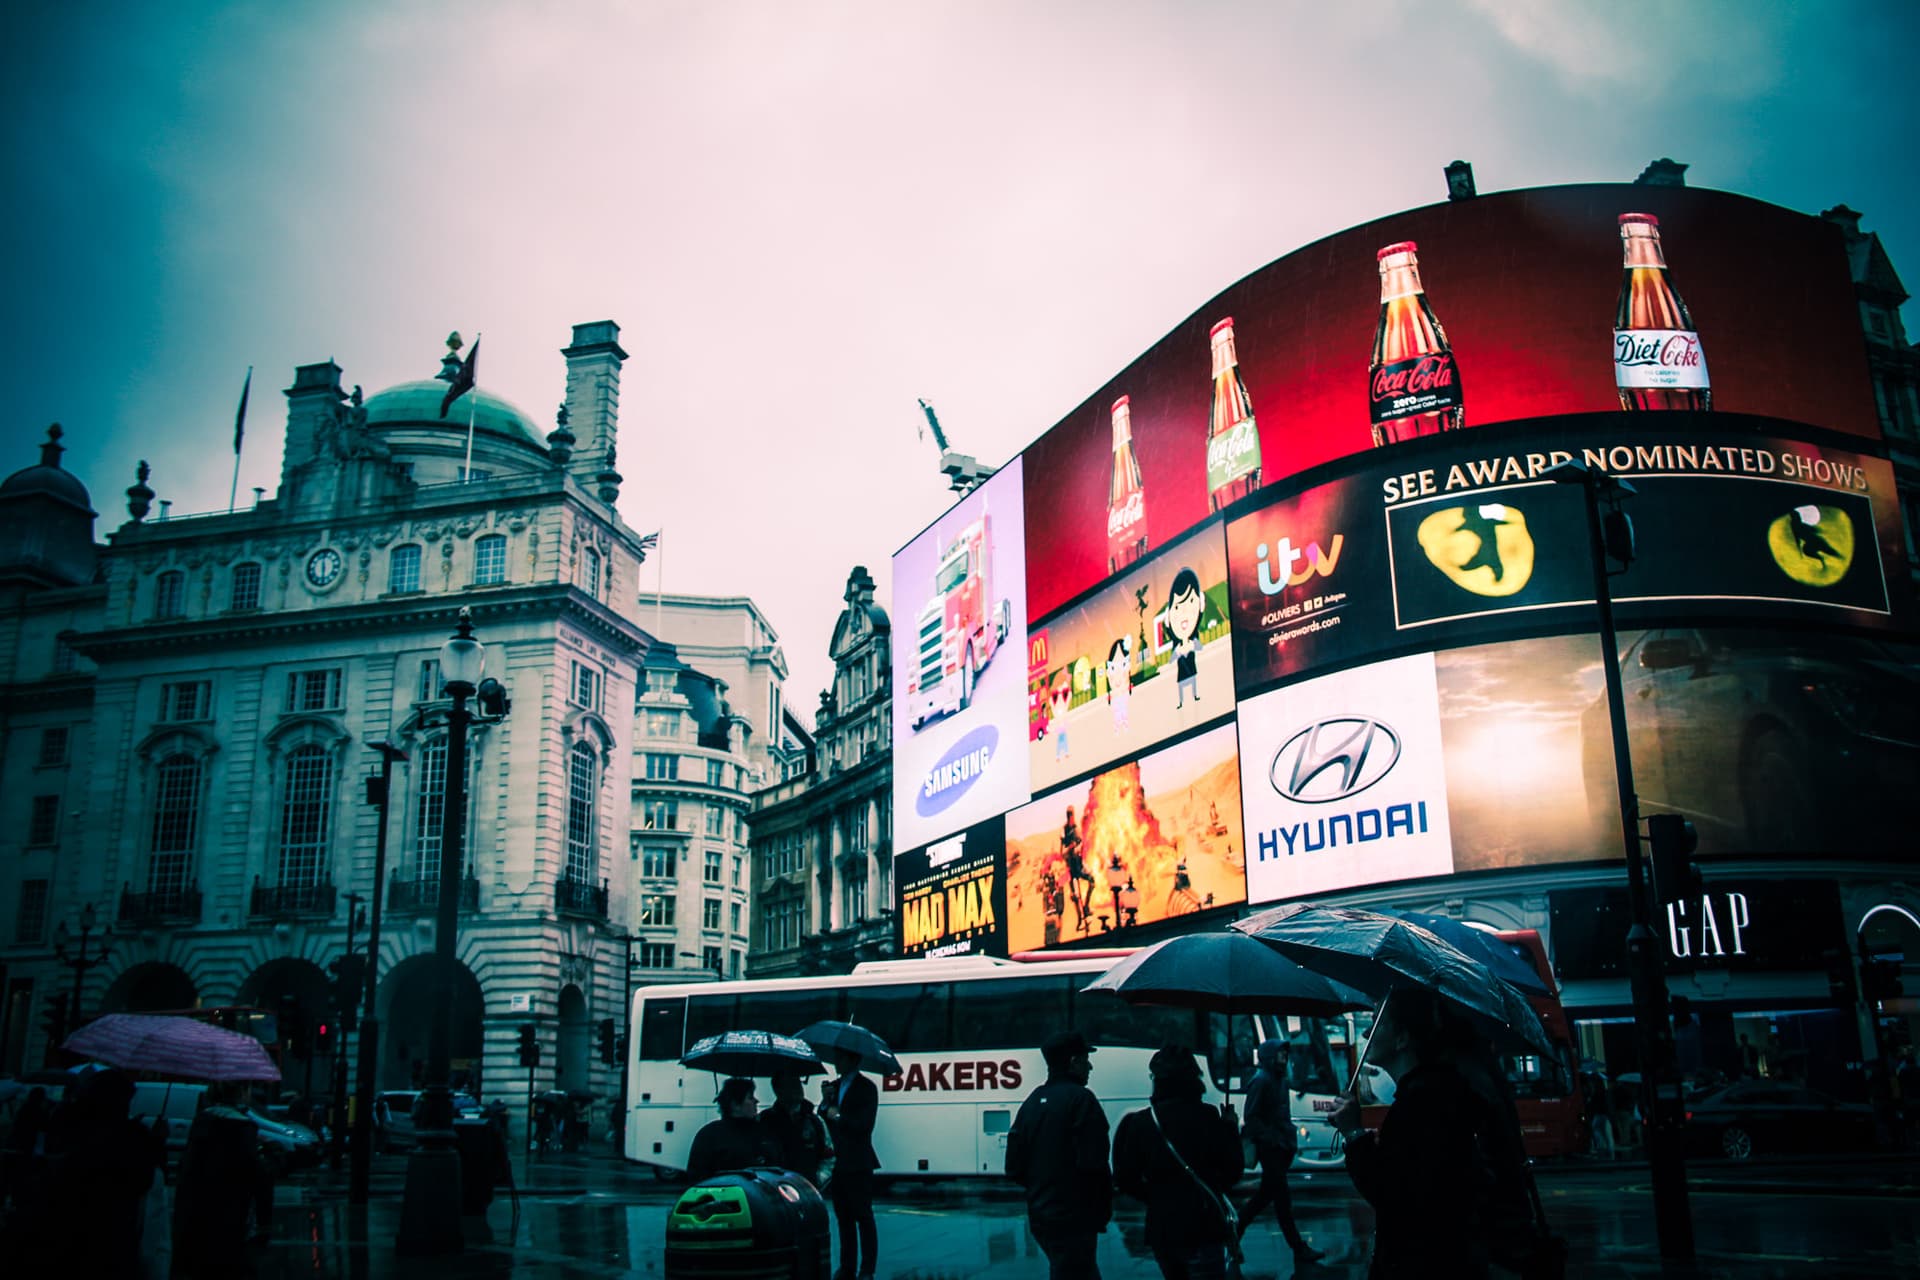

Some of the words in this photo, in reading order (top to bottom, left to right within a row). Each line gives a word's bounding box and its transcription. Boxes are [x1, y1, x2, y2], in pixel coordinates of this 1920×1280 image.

[1616, 334, 1660, 366] Diet
[1660, 334, 1700, 366] Coke
[1372, 355, 1453, 402] Coca-Cola
[1393, 396, 1417, 409] zero
[1383, 469, 1437, 504] SEE
[1582, 445, 1776, 473] NOMINATED
[1782, 453, 1868, 491] SHOWS
[1257, 534, 1344, 595] itv
[925, 746, 989, 797] SAMSUNG
[1259, 801, 1428, 862] HYUNDAI
[903, 892, 945, 948] MAD
[948, 874, 995, 935] MAX
[1667, 892, 1749, 957] GAP
[882, 1060, 1023, 1092] BAKERS
